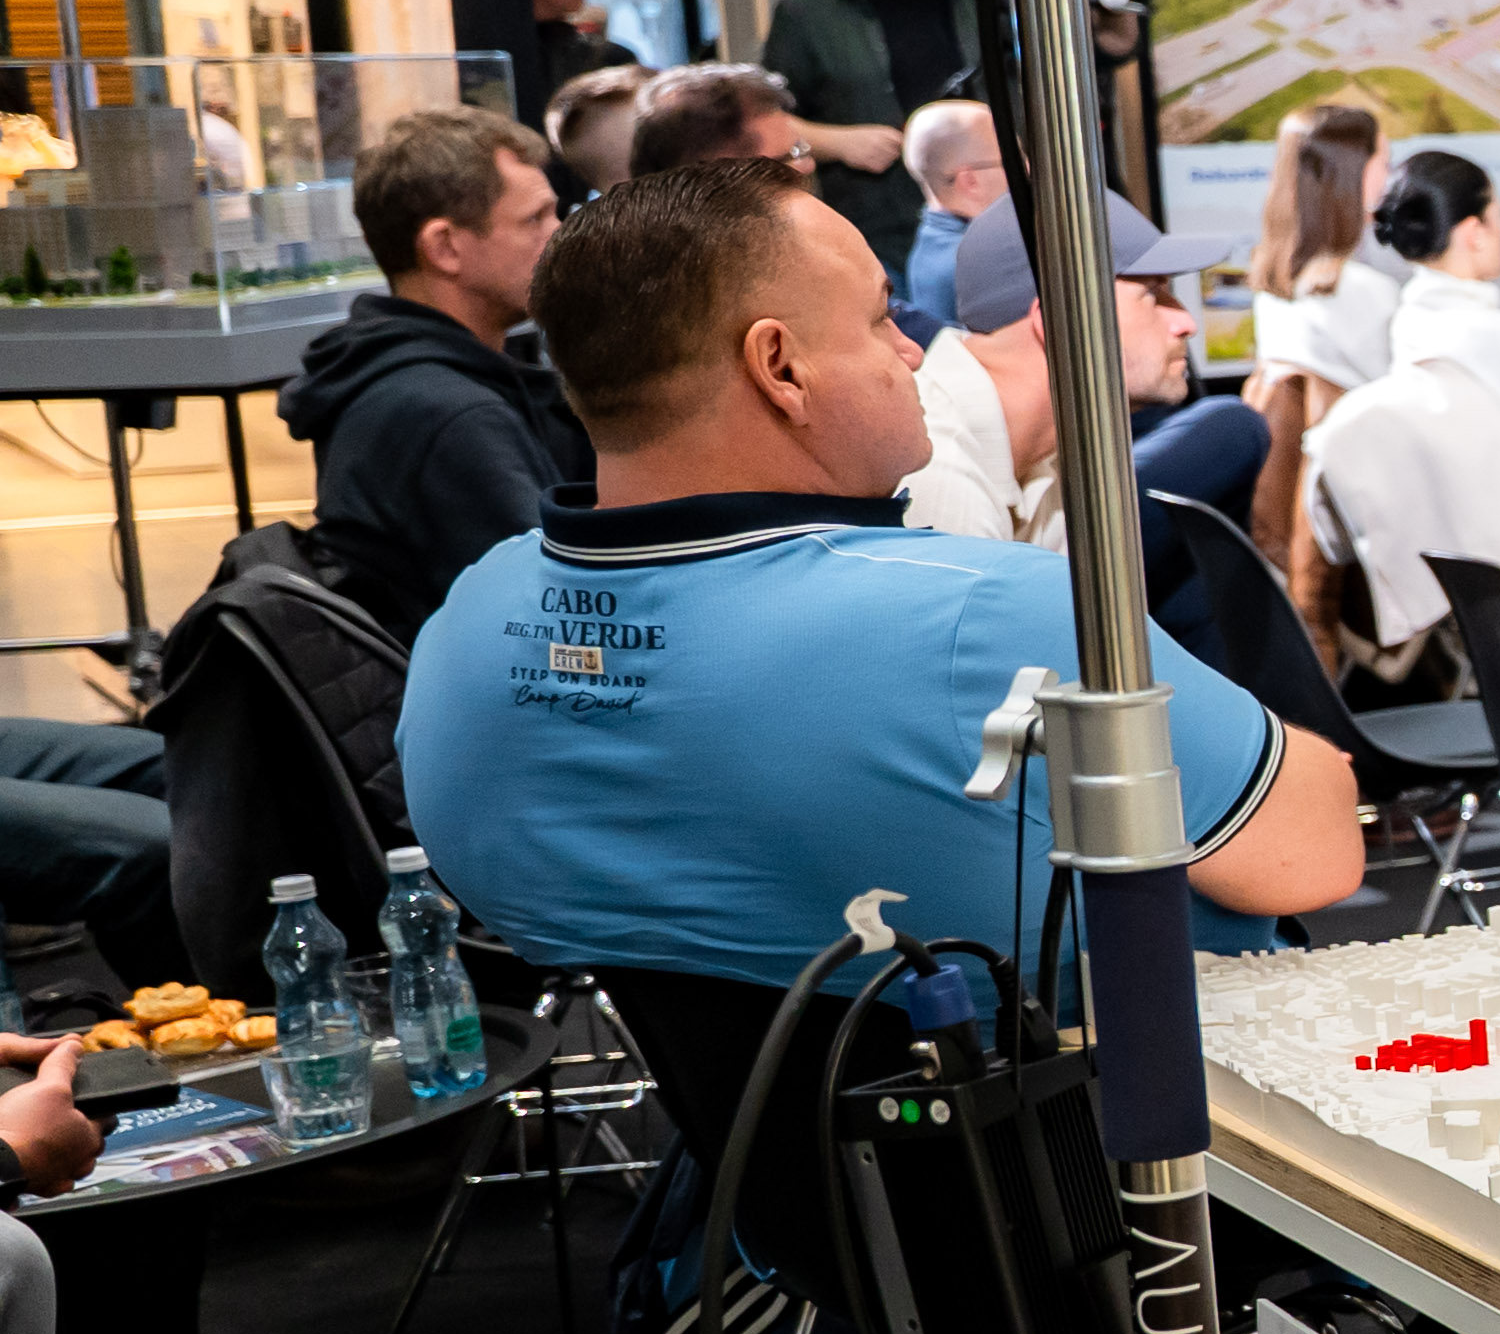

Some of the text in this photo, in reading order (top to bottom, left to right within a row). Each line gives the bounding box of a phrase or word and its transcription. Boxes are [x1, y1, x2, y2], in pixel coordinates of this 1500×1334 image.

[541, 587, 617, 617] CABO
[503, 619, 666, 650] REG.TM VERDE
[554, 655, 583, 669] CREW
[510, 666, 647, 688] STEP ON BOARD
